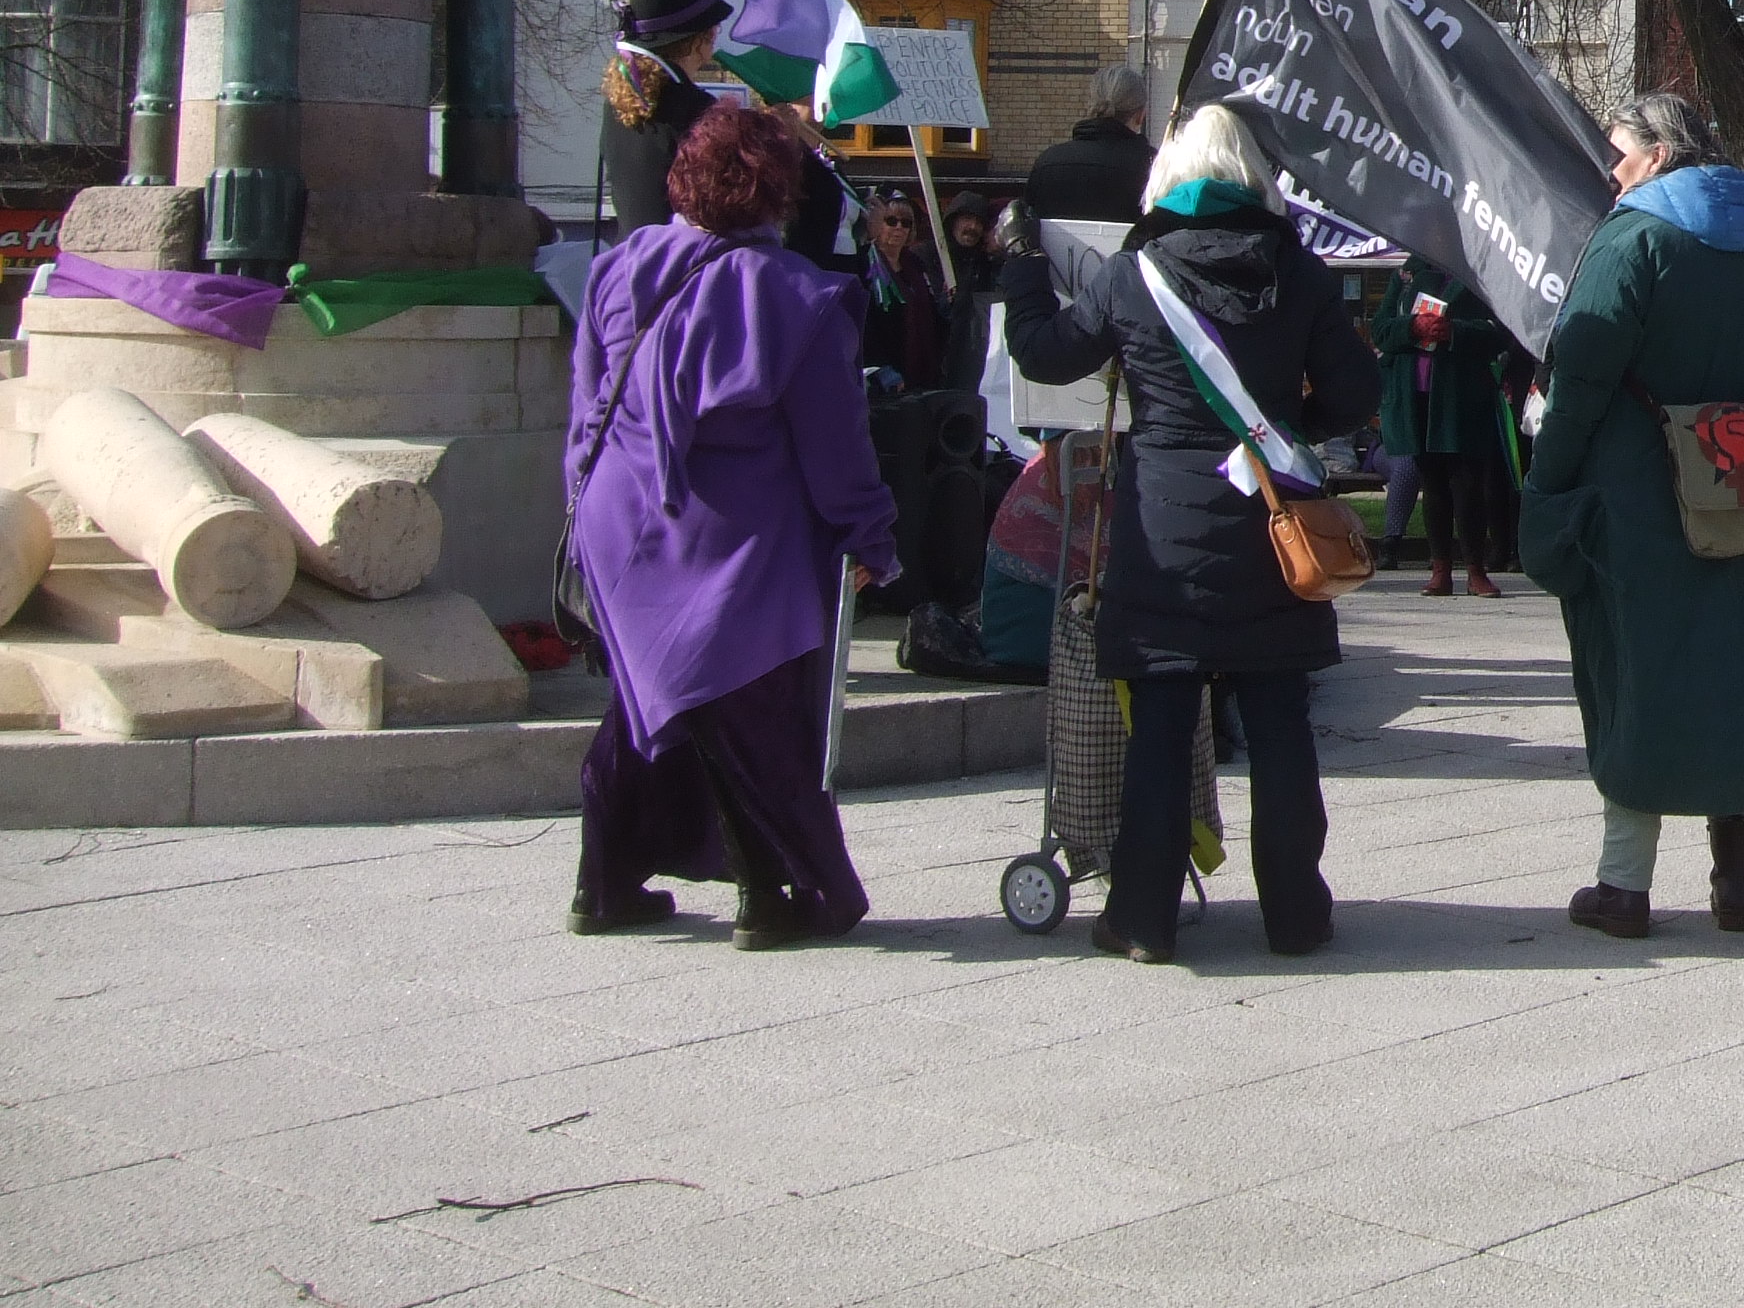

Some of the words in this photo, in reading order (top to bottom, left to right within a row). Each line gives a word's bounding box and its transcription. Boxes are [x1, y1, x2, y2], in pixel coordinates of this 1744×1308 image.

[1234, 5, 1314, 57] noun
[897, 78, 979, 100] RECTNESS
[911, 99, 976, 124] POLICE
[1211, 52, 1319, 122] adult
[1322, 96, 1453, 198] human
[1461, 180, 1566, 304] female
[26, 218, 60, 251] H
